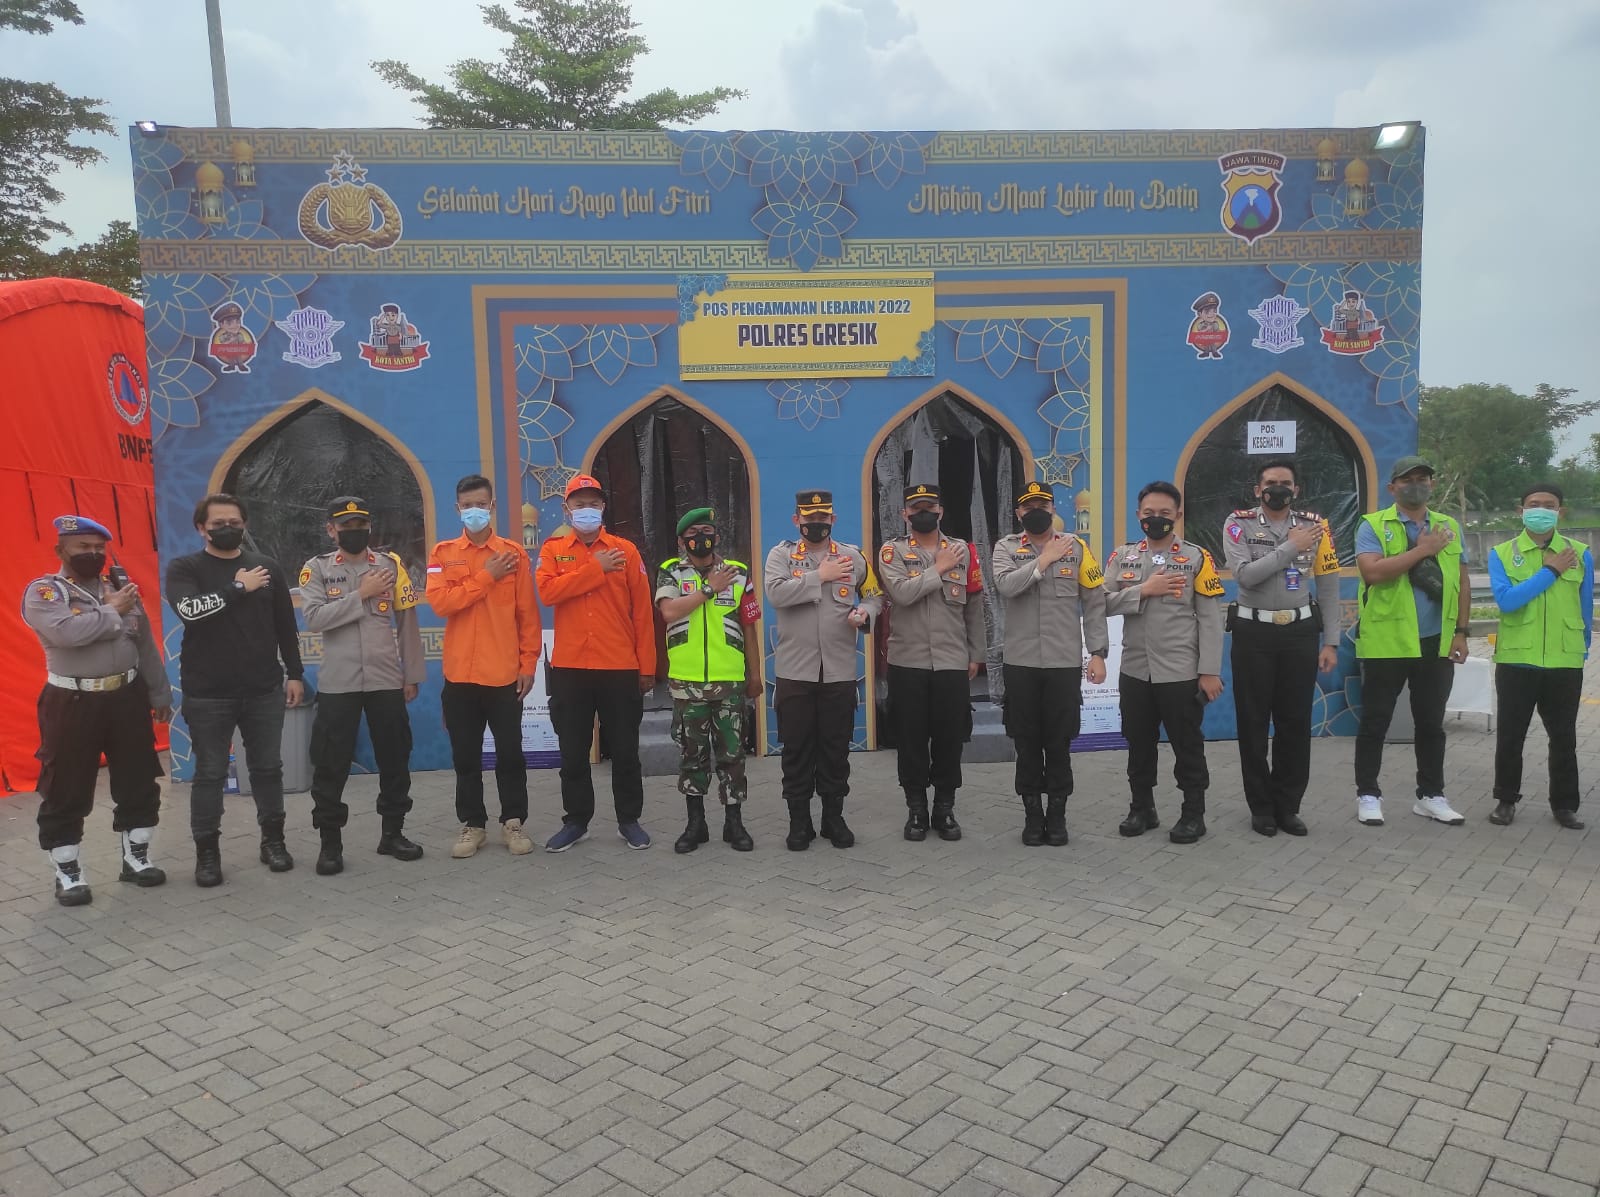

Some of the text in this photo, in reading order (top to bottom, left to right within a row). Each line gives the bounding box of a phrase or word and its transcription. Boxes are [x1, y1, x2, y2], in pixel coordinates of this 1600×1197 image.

[1225, 155, 1280, 168] JAWA TIMUR
[505, 185, 554, 219] Hari
[559, 184, 616, 219] Raya
[620, 185, 654, 218] Idul
[659, 184, 711, 216] Fitri
[987, 182, 1047, 216] Maaf
[1053, 181, 1099, 216] Lahir
[1103, 181, 1136, 213] dan
[1140, 179, 1200, 212] Batin
[703, 299, 911, 317] POS PENGAMANAN LEBARAN 2022
[737, 322, 878, 348] POLRES GRESIK
[374, 355, 416, 366] KOTA SANTRI
[1260, 424, 1276, 434] POS
[1252, 435, 1284, 449] KESEHATAN
[192, 593, 224, 615] Dutch
